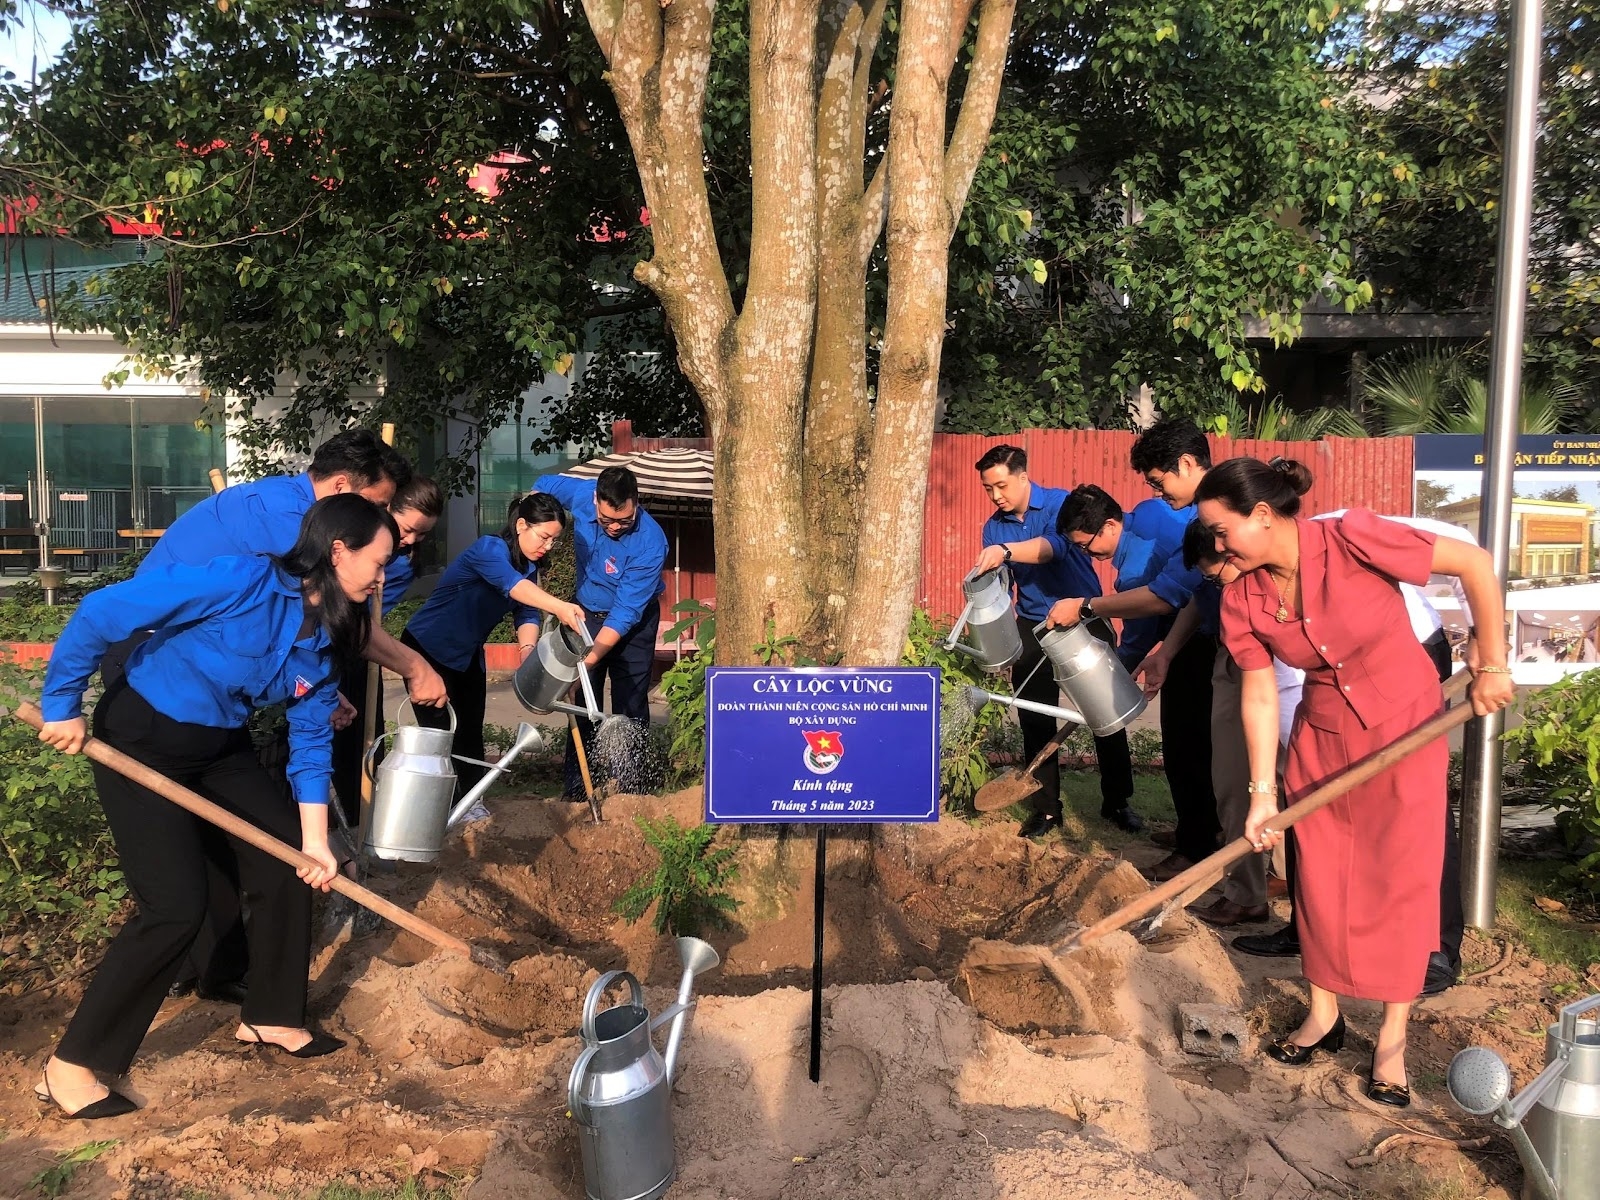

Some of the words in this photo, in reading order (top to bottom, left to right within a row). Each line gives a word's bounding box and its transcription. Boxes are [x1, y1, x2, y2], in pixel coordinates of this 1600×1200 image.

[1566, 441, 1585, 449] BAN
[1535, 450, 1567, 465] TIẾP
[753, 675, 791, 693] CÂY
[796, 677, 835, 696] LỘC
[839, 675, 893, 693] VỪNG
[717, 701, 746, 711] ĐOÀN
[748, 701, 783, 711] THÀNH
[785, 701, 809, 711] NIÊN
[811, 702, 840, 712] CỘNG
[841, 701, 861, 711] SẢN
[863, 701, 879, 711] HỒ
[880, 701, 899, 711] CHÍ
[901, 703, 928, 711] MINH
[789, 716, 803, 726] BỘ
[805, 715, 825, 725] XÂY
[828, 716, 857, 726] DỰNG
[792, 779, 823, 791] Kính
[825, 780, 854, 794] tặng
[771, 800, 808, 813] Tháng
[810, 800, 818, 811] 5
[820, 801, 845, 811] năm
[847, 800, 875, 811] 2023
